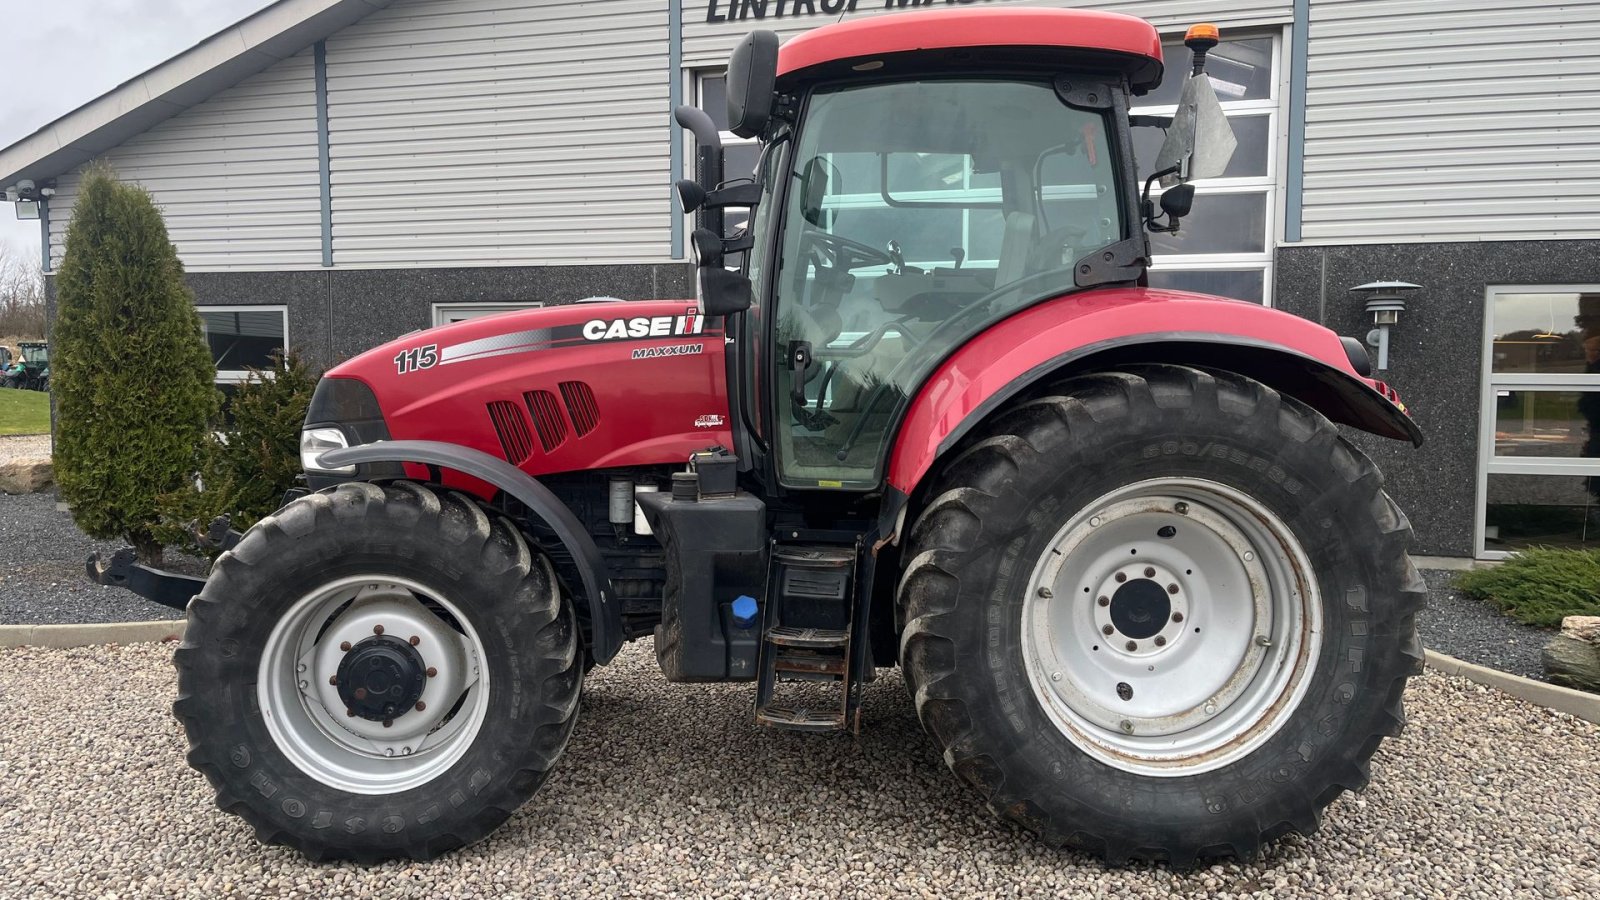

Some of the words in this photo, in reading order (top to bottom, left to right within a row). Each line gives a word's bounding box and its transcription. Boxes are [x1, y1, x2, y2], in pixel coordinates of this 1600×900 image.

[583, 316, 672, 340] CASE
[394, 344, 437, 375] 115
[632, 344, 703, 359] MAXXUM
